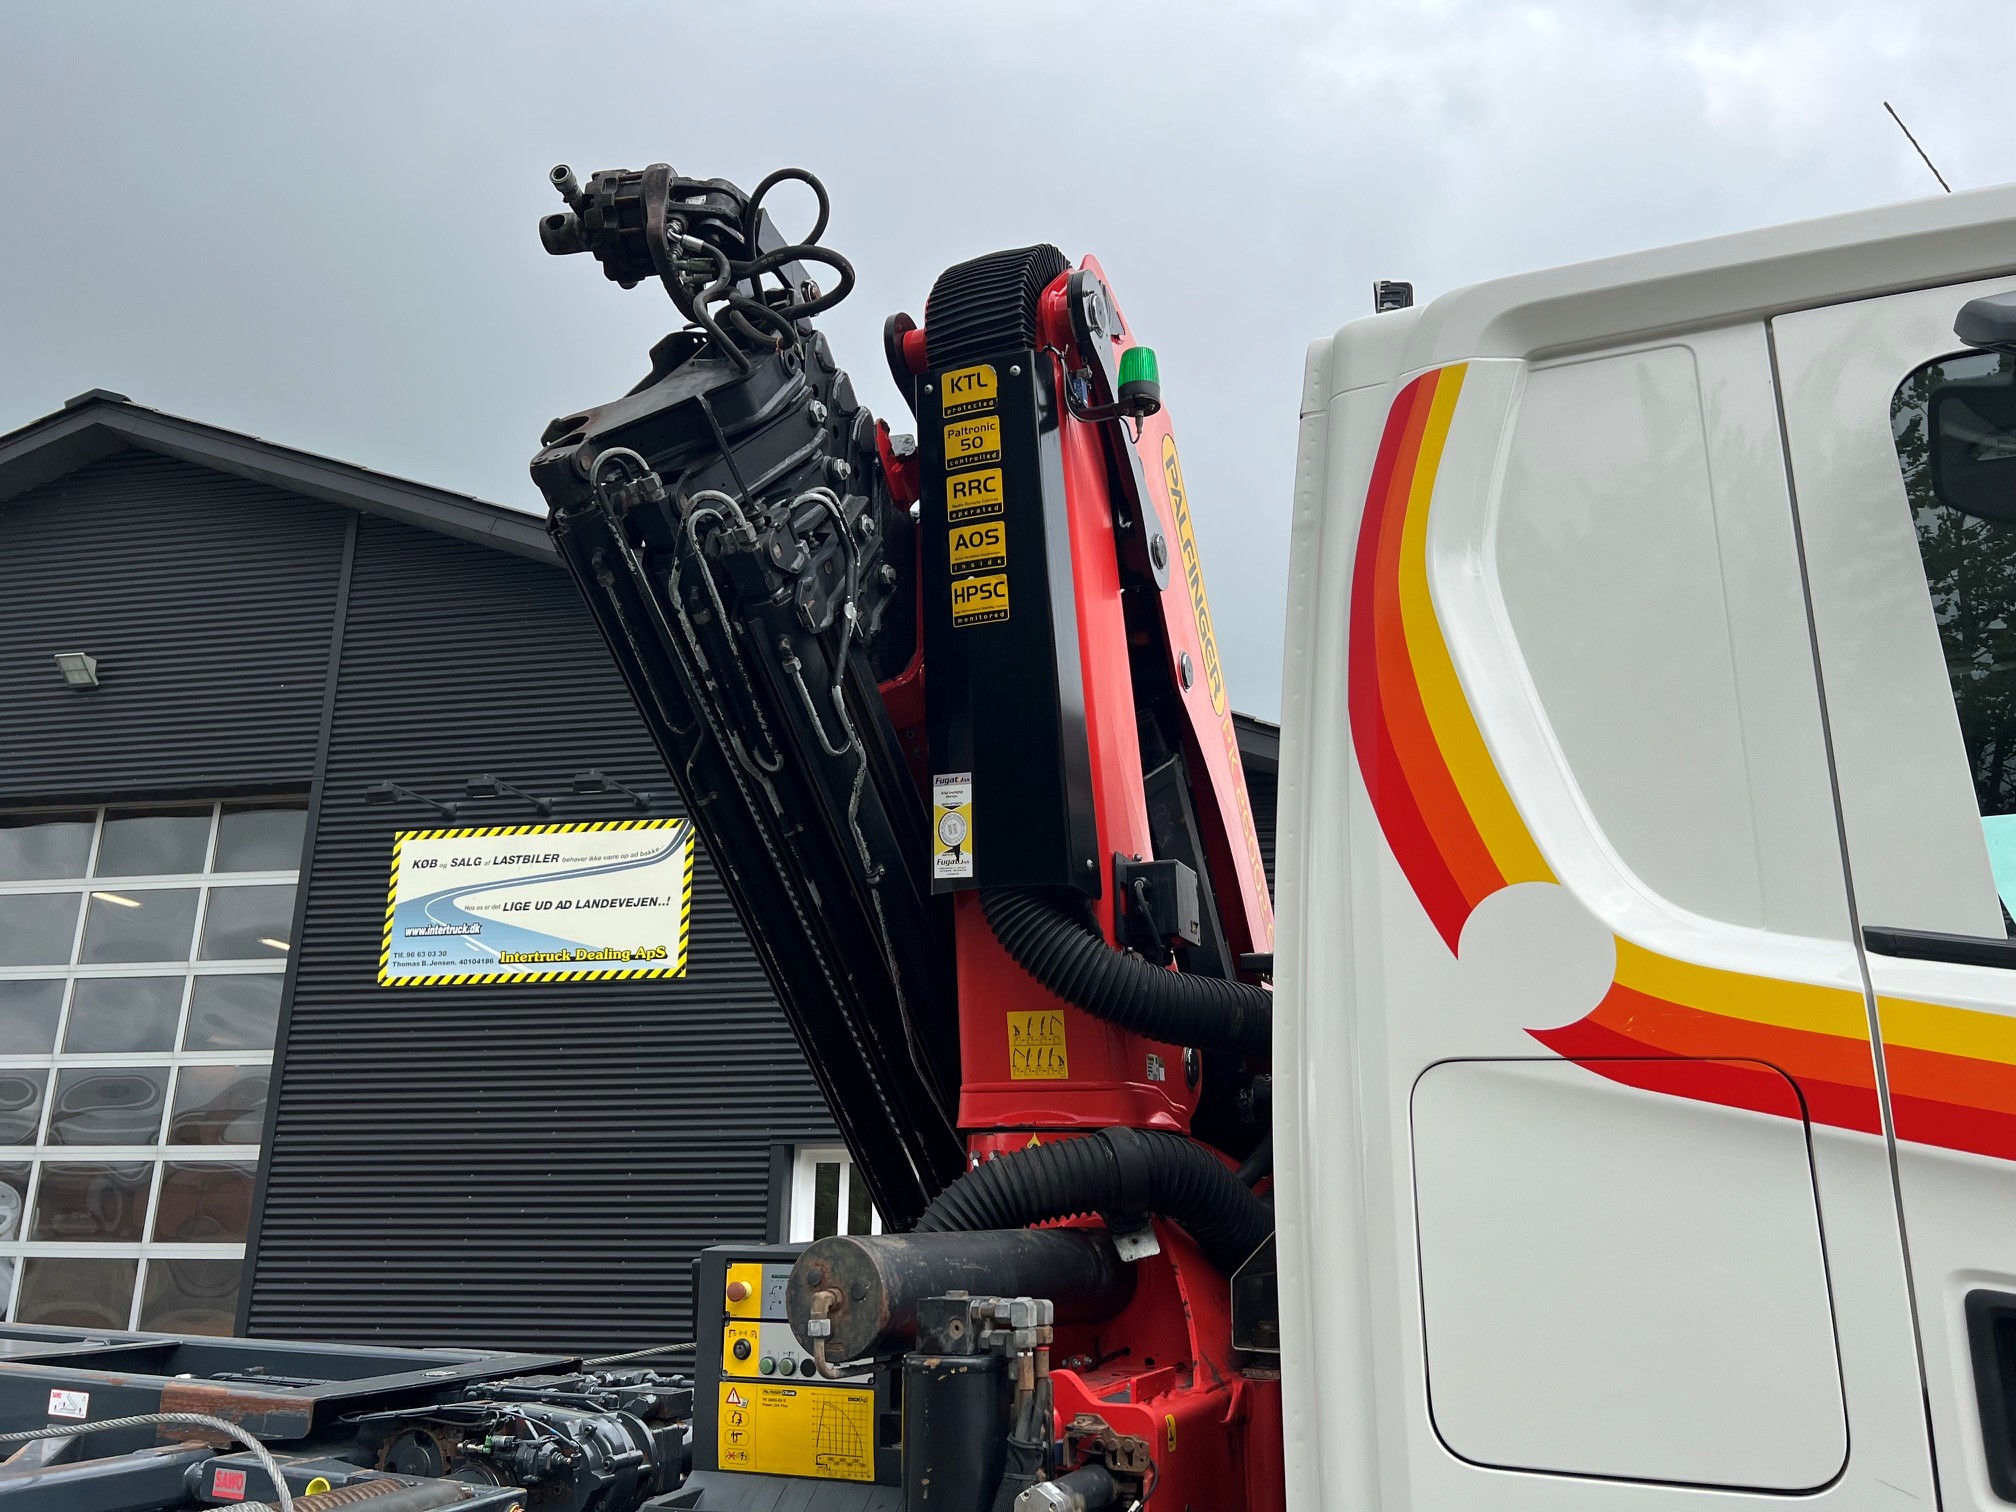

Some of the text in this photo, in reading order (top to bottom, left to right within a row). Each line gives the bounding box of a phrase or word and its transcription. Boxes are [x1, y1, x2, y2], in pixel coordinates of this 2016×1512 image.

[951, 372, 988, 393] KTL
[947, 400, 994, 415] protected
[948, 422, 996, 439] Paltronic
[960, 436, 984, 451] 50
[949, 452, 997, 466] controlled
[953, 476, 996, 499] RRC
[952, 504, 999, 518] operated
[954, 528, 1000, 551] AOS
[954, 558, 1002, 571] inside
[1166, 453, 1223, 701] PALFINGER
[954, 581, 1006, 604] HPSC
[957, 611, 1005, 623] monitored
[1222, 717, 1237, 776] PK
[412, 859, 438, 869] KØB
[450, 857, 482, 867] SALG
[492, 853, 560, 865] LASTBILER
[503, 901, 531, 911] LIGE
[534, 900, 553, 910] UD
[555, 900, 572, 910] AD
[575, 896, 671, 909] LANDEVEJEN..!
[405, 923, 481, 937] www.intertruck.dk
[459, 957, 494, 965] 40104186
[500, 945, 667, 963] Intertruck Dealing ApS
[215, 1470, 243, 1491] SAWO
